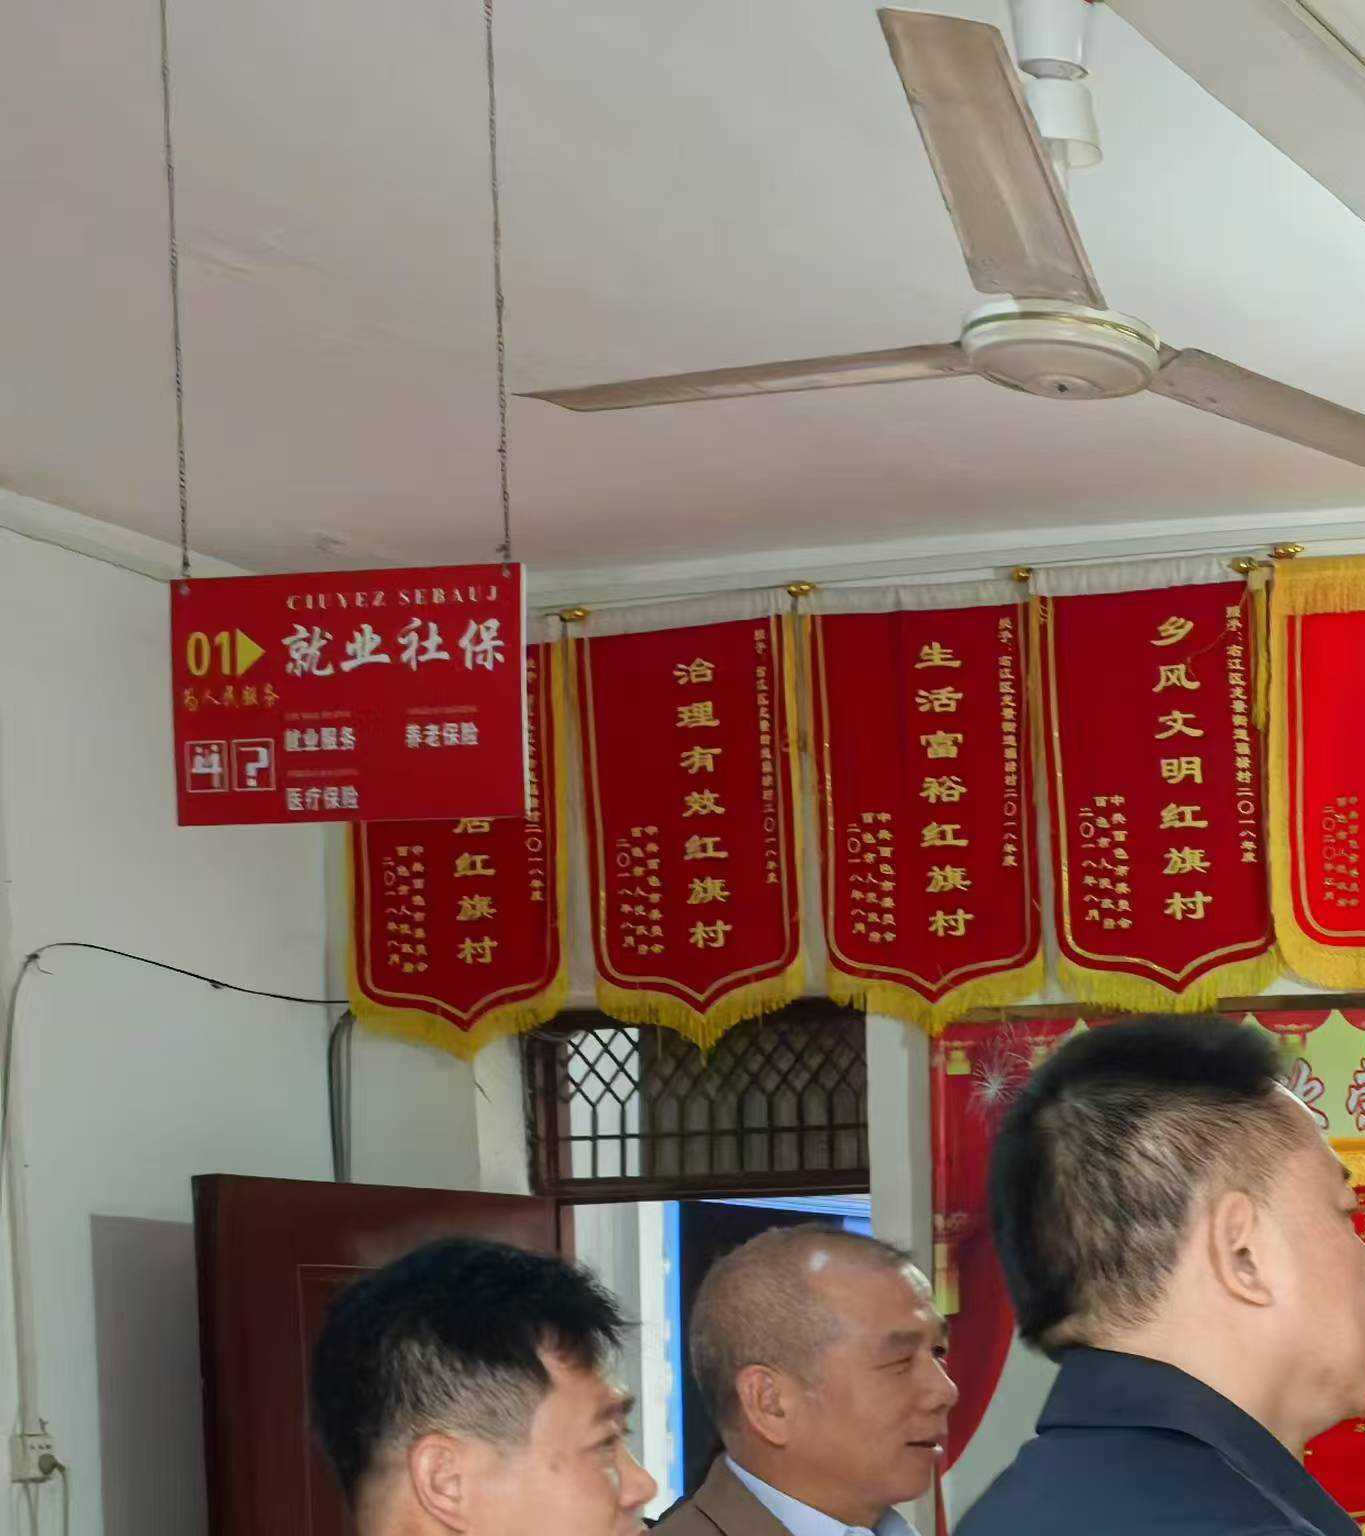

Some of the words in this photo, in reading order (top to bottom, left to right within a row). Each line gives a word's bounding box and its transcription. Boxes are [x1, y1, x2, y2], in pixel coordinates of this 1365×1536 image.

[398, 584, 500, 605] SEBAUJ
[186, 631, 231, 676] 01
[281, 617, 505, 677] 就业社保
[405, 722, 479, 749] 养老保险
[914, 641, 975, 937] 生活富裕红旗村
[1150, 615, 1213, 921] 乡风文明红旗村
[672, 657, 733, 949] 治理有效红旗村
